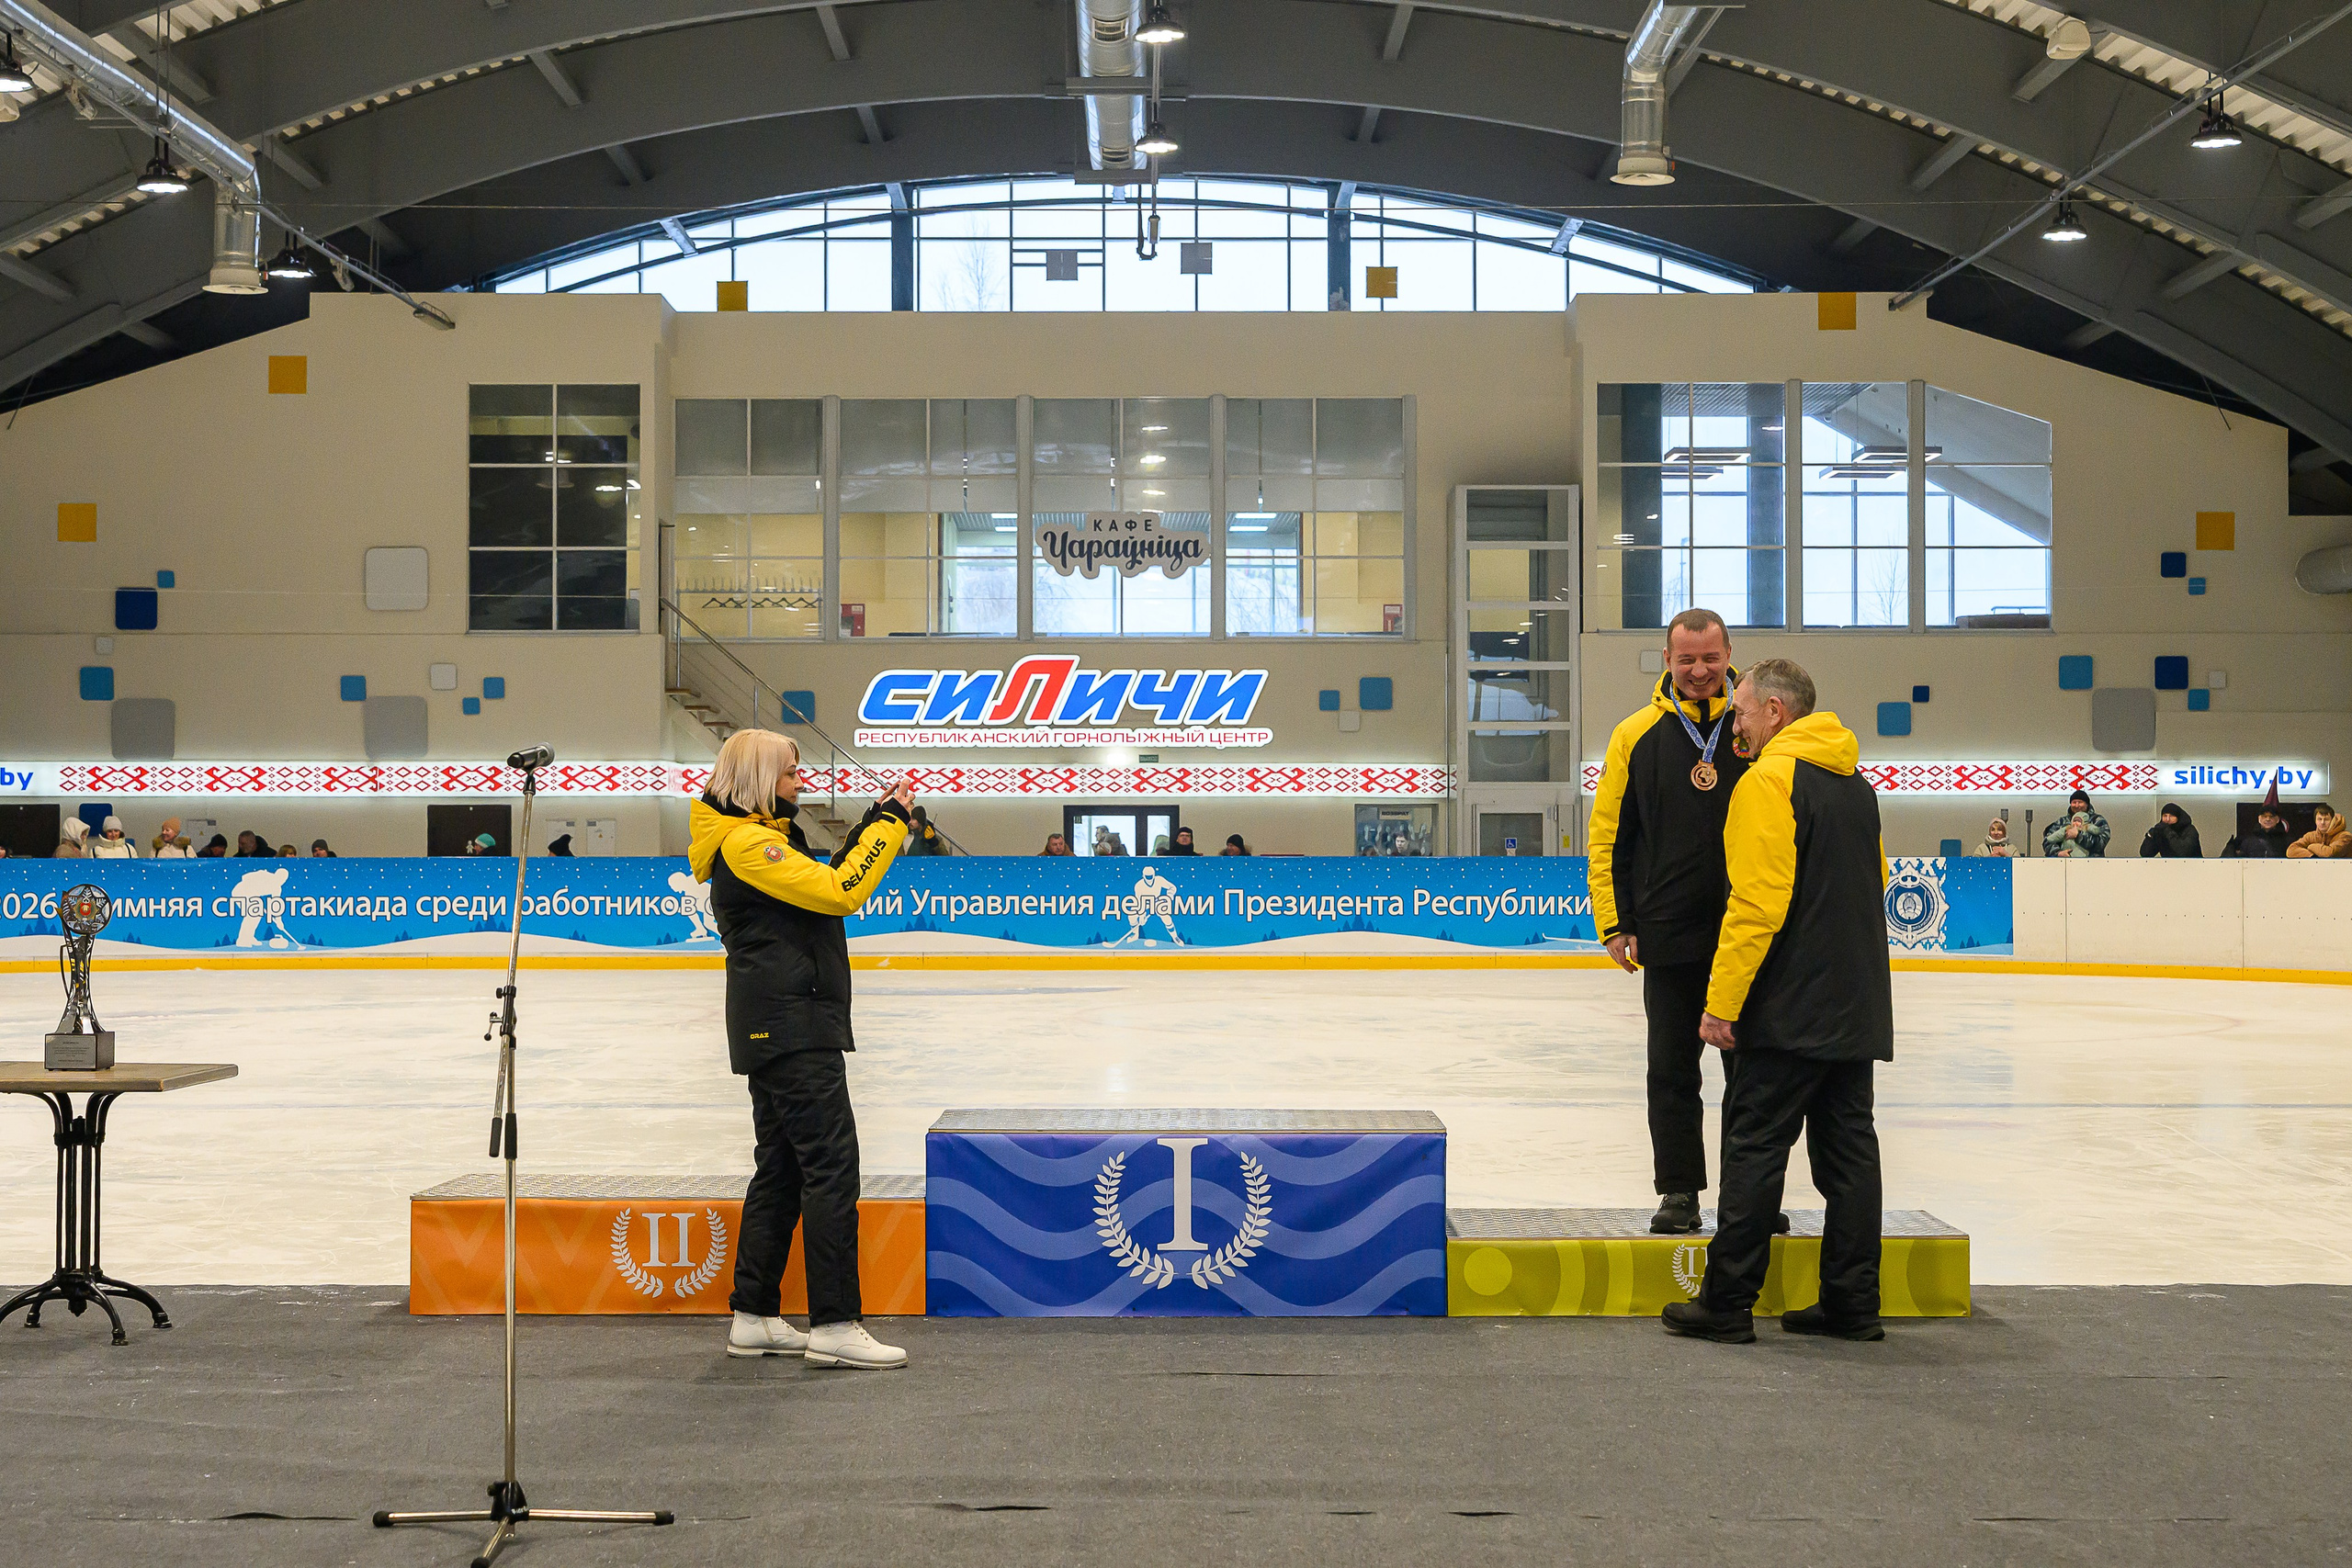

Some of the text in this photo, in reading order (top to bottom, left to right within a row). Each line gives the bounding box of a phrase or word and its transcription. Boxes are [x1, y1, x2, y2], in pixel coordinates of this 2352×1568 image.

[1093, 519, 1152, 533] КАФЕ
[1043, 529, 1204, 570] Чараўніца
[858, 730, 1269, 746] РЕСПУБЛИКАНСКИЙ ГОРНОЛЫЖНЫЙ ЦЕНТР
[2174, 765, 2313, 789] silichy.by
[841, 838, 888, 892] BELARUS
[0, 892, 58, 919] 026
[111, 897, 203, 919] имняя
[211, 895, 407, 923] спартакиада
[415, 895, 507, 923] среди
[520, 887, 697, 922] работников
[911, 888, 1094, 922] Управления
[1102, 894, 1215, 922] делами
[1224, 888, 1405, 922] Президента
[1413, 887, 1591, 923] Республики
[641, 1212, 696, 1268] II
